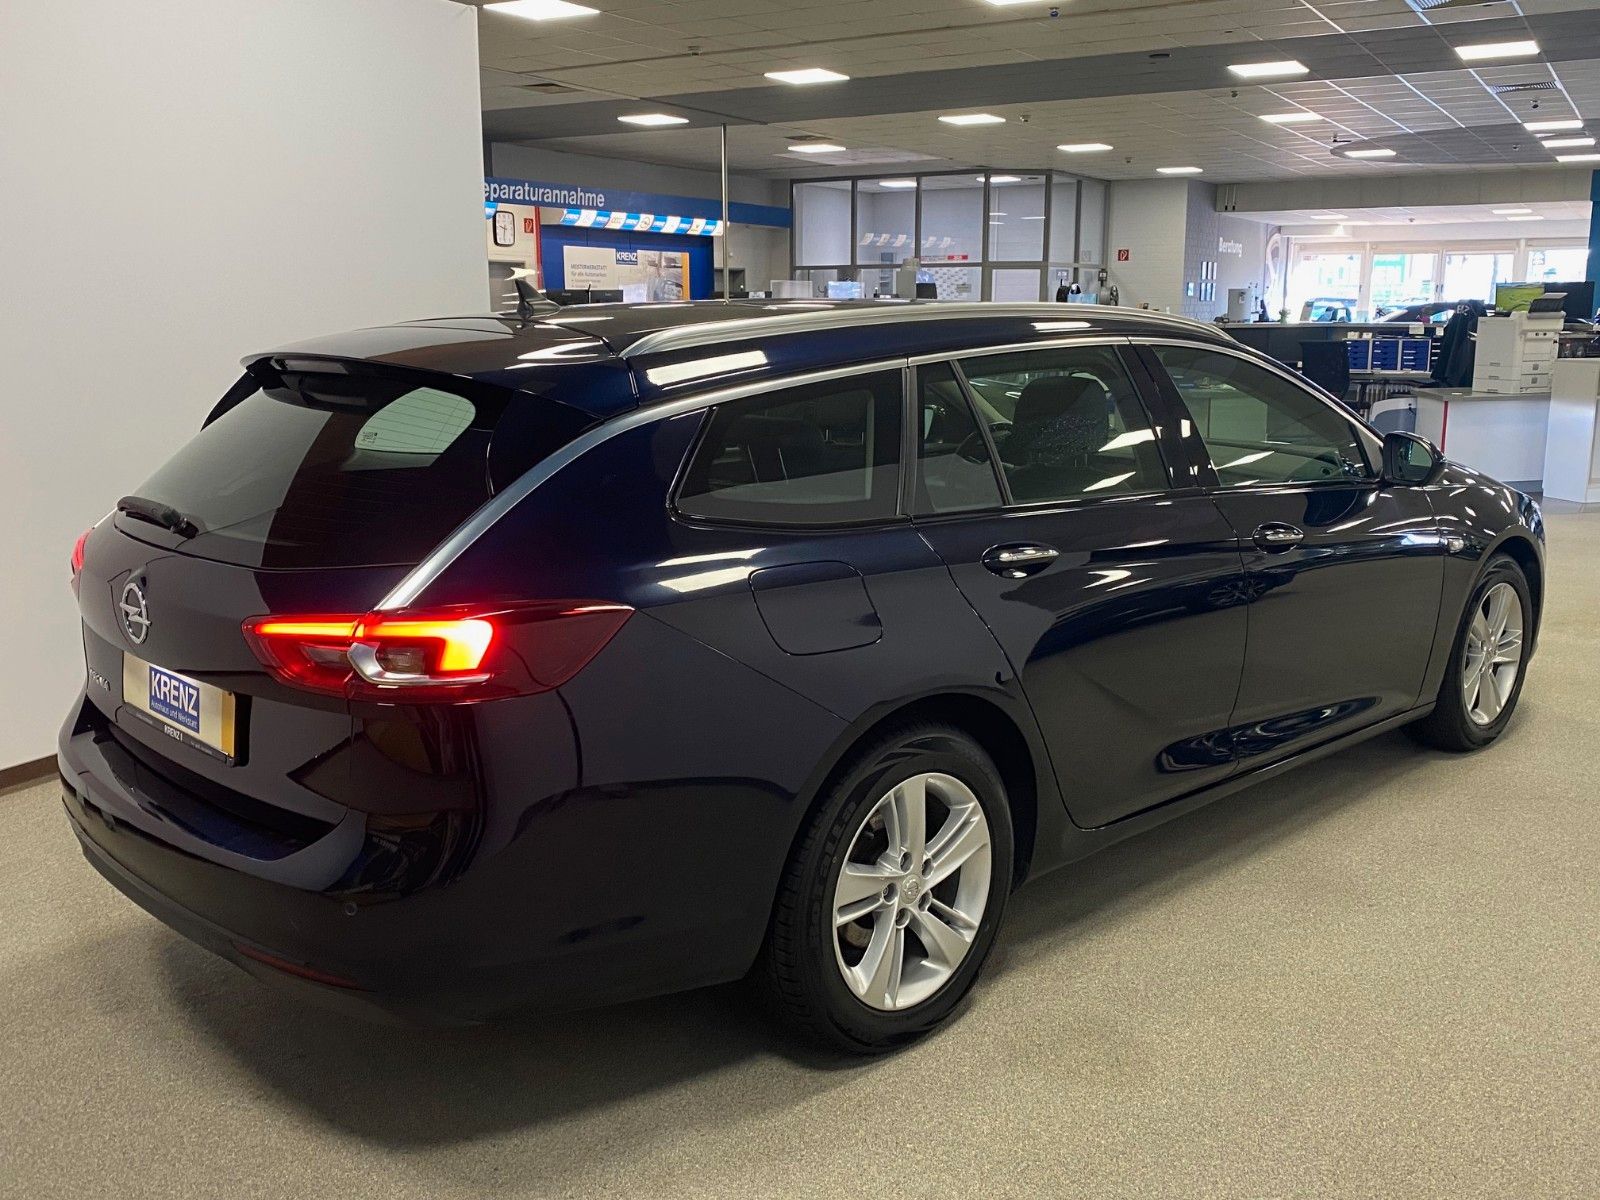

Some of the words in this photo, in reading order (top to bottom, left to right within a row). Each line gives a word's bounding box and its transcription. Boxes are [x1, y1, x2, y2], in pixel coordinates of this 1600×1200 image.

[616, 251, 638, 261] KRENZ
[151, 670, 198, 717] KRENZ
[164, 724, 180, 740] KRENZ
